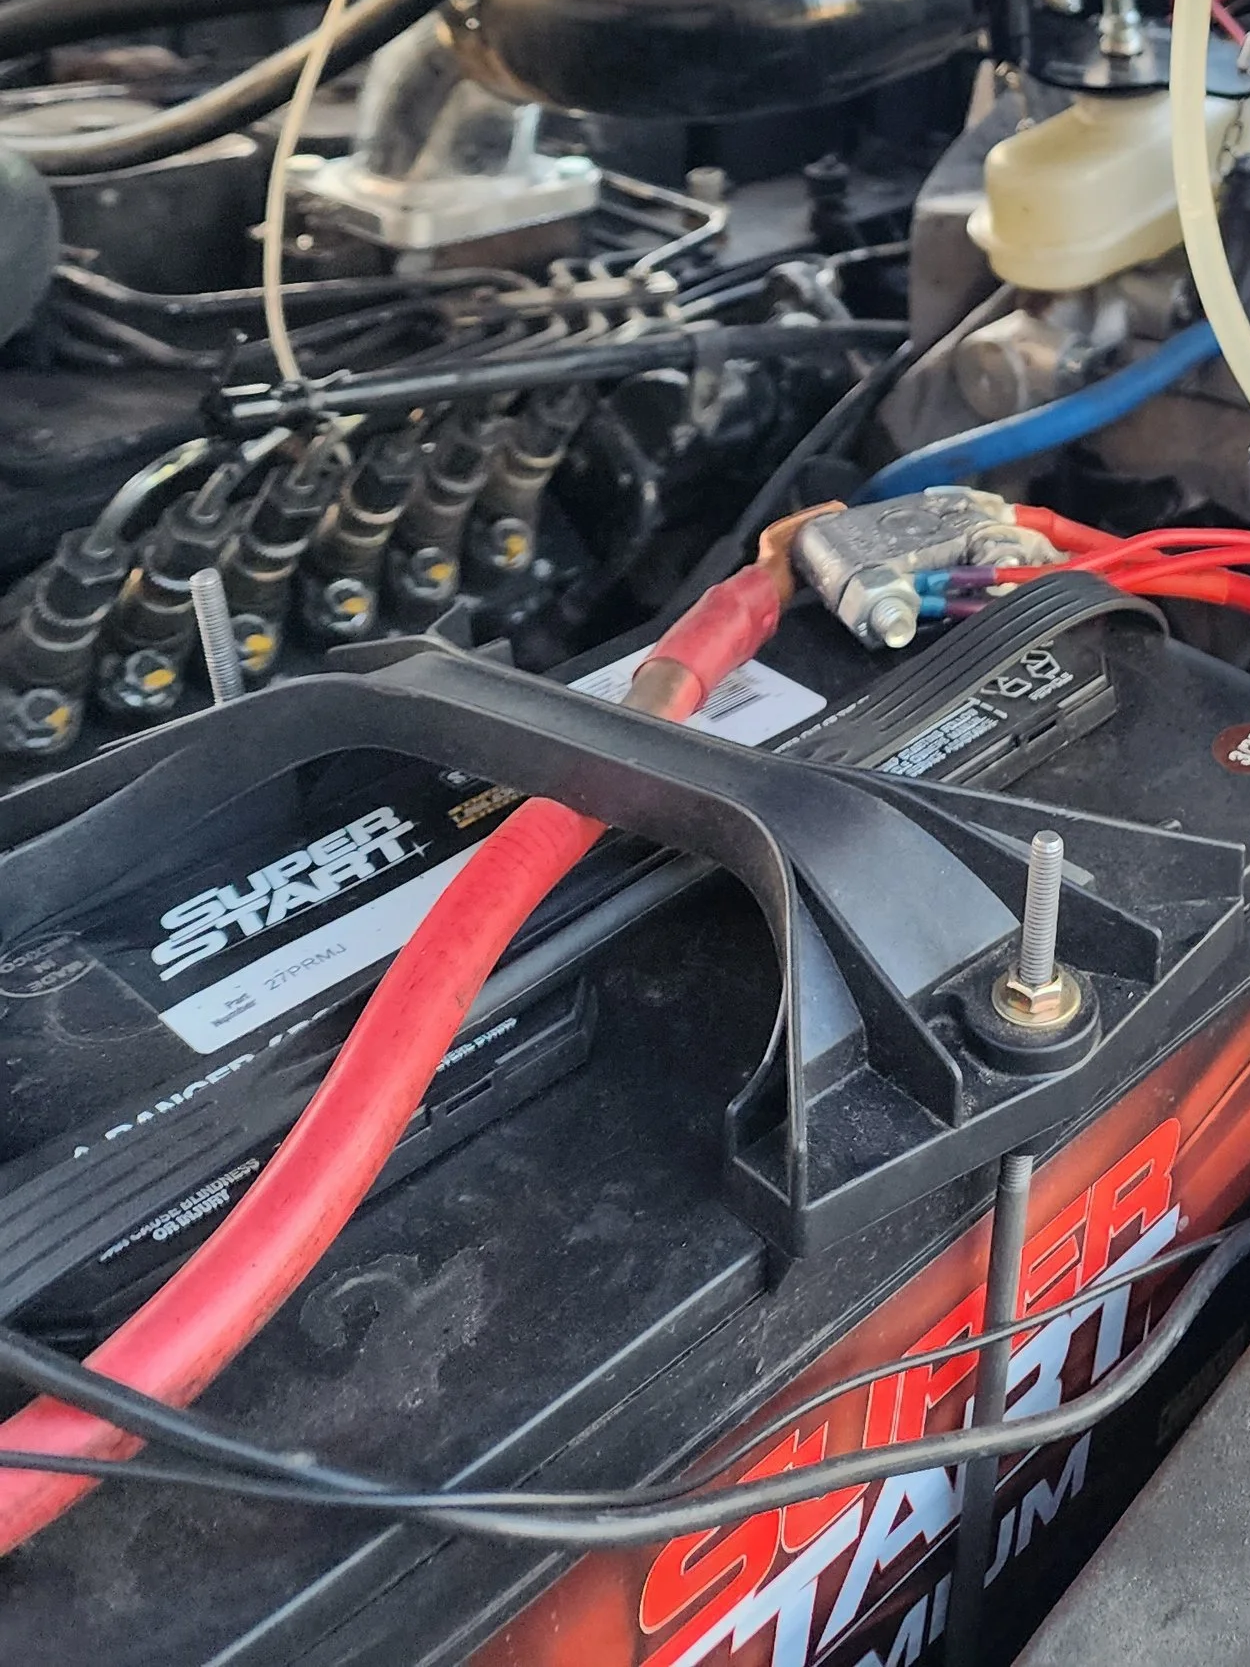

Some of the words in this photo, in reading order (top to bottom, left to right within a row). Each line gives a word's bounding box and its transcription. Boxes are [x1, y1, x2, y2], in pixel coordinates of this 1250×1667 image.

[159, 806, 401, 930] SUPER
[151, 820, 415, 982] START
[263, 942, 348, 991] 27PRMJ
[211, 998, 257, 1028] Number
[224, 992, 250, 1010] Part
[179, 1158, 262, 1212] BLINDNESS
[152, 1220, 180, 1241] OR
[176, 1188, 231, 1227] INJURY
